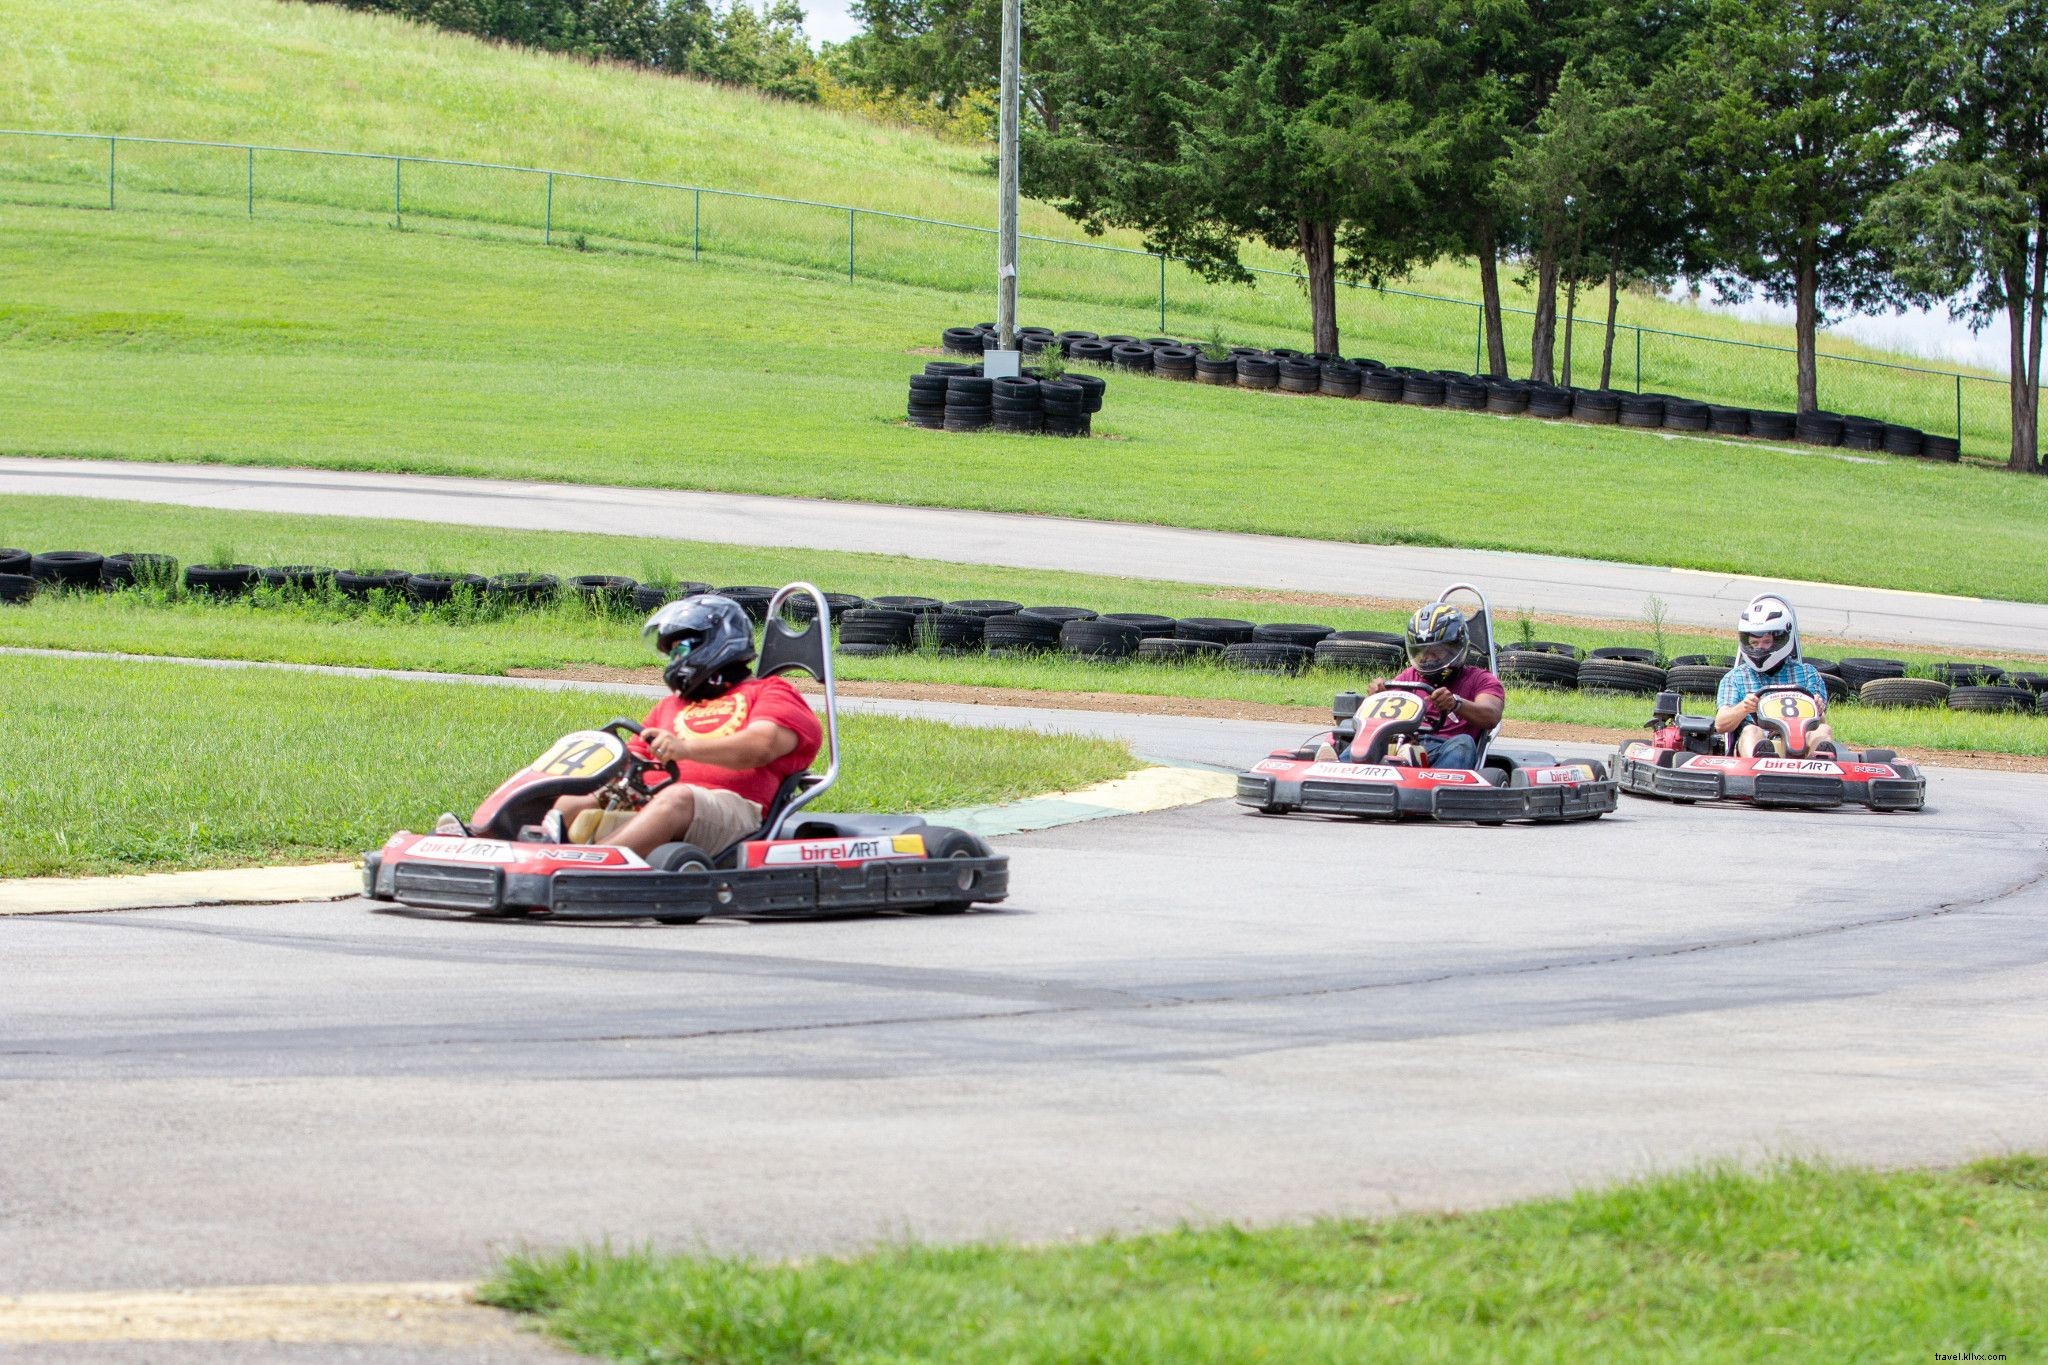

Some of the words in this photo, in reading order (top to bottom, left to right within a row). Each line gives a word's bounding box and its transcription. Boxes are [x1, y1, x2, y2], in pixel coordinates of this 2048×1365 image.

[1368, 697, 1407, 719] 13
[1780, 697, 1799, 717] 8
[543, 740, 605, 775] 14
